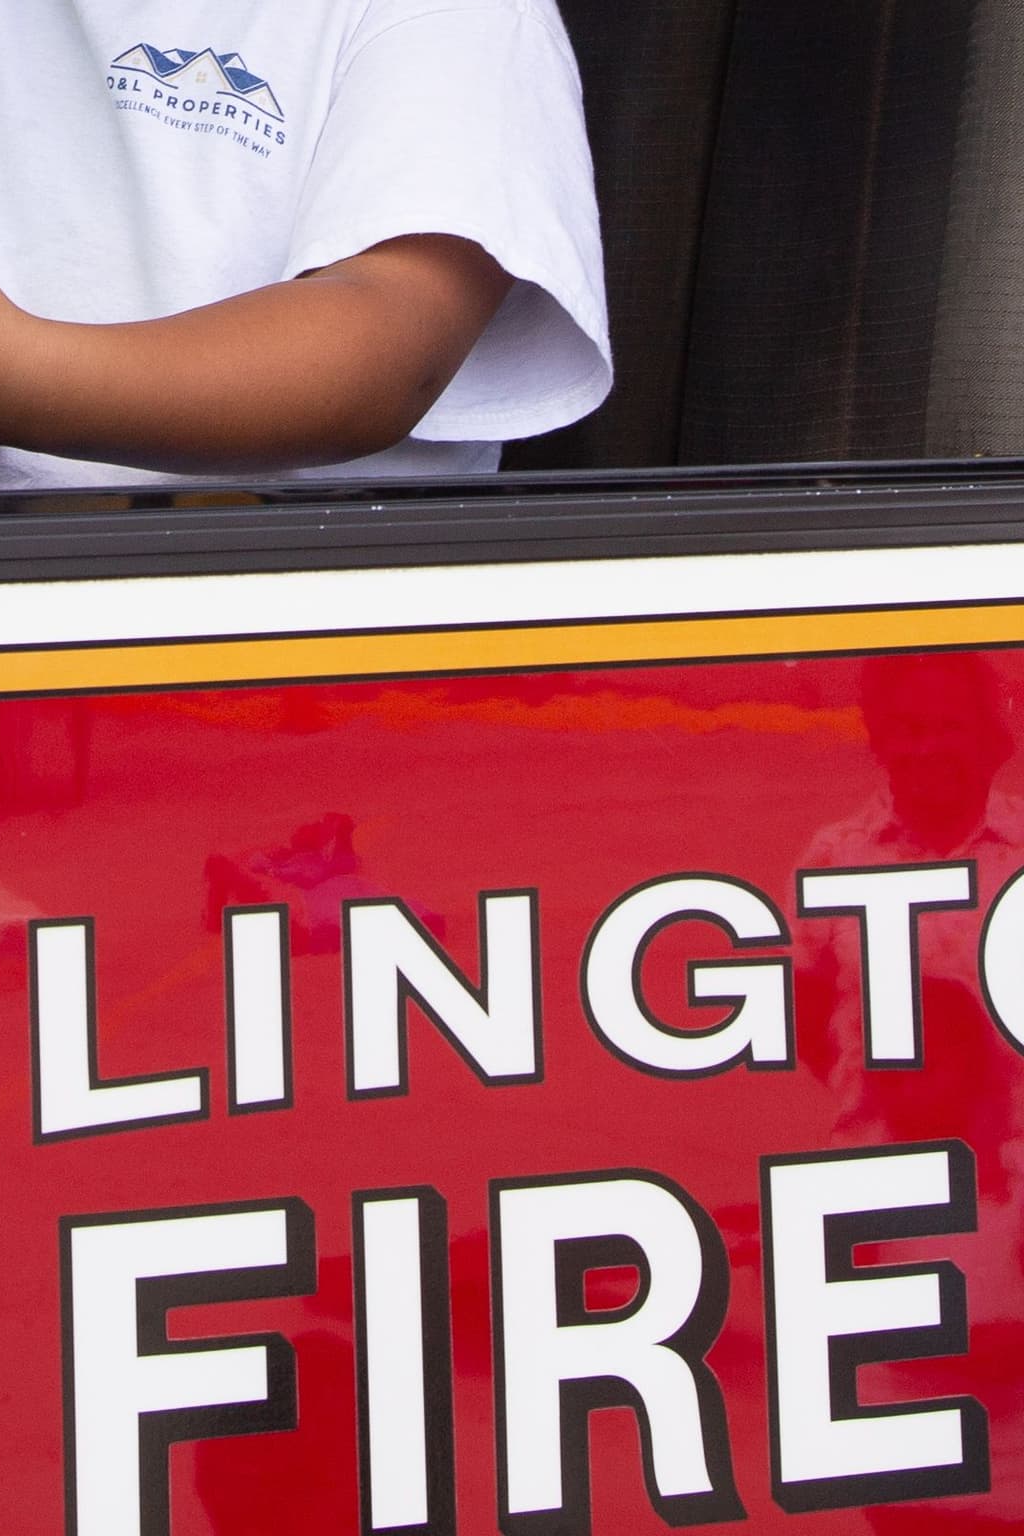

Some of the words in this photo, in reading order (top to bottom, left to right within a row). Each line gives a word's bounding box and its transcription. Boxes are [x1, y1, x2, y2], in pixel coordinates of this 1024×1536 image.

[153, 88, 286, 145] PROPERTIES
[164, 116, 192, 132] EVERY
[194, 123, 214, 134] STEP
[216, 125, 230, 136] OF
[232, 132, 248, 148] THE
[251, 142, 272, 159] WAY
[60, 1138, 990, 1536] FIRE
